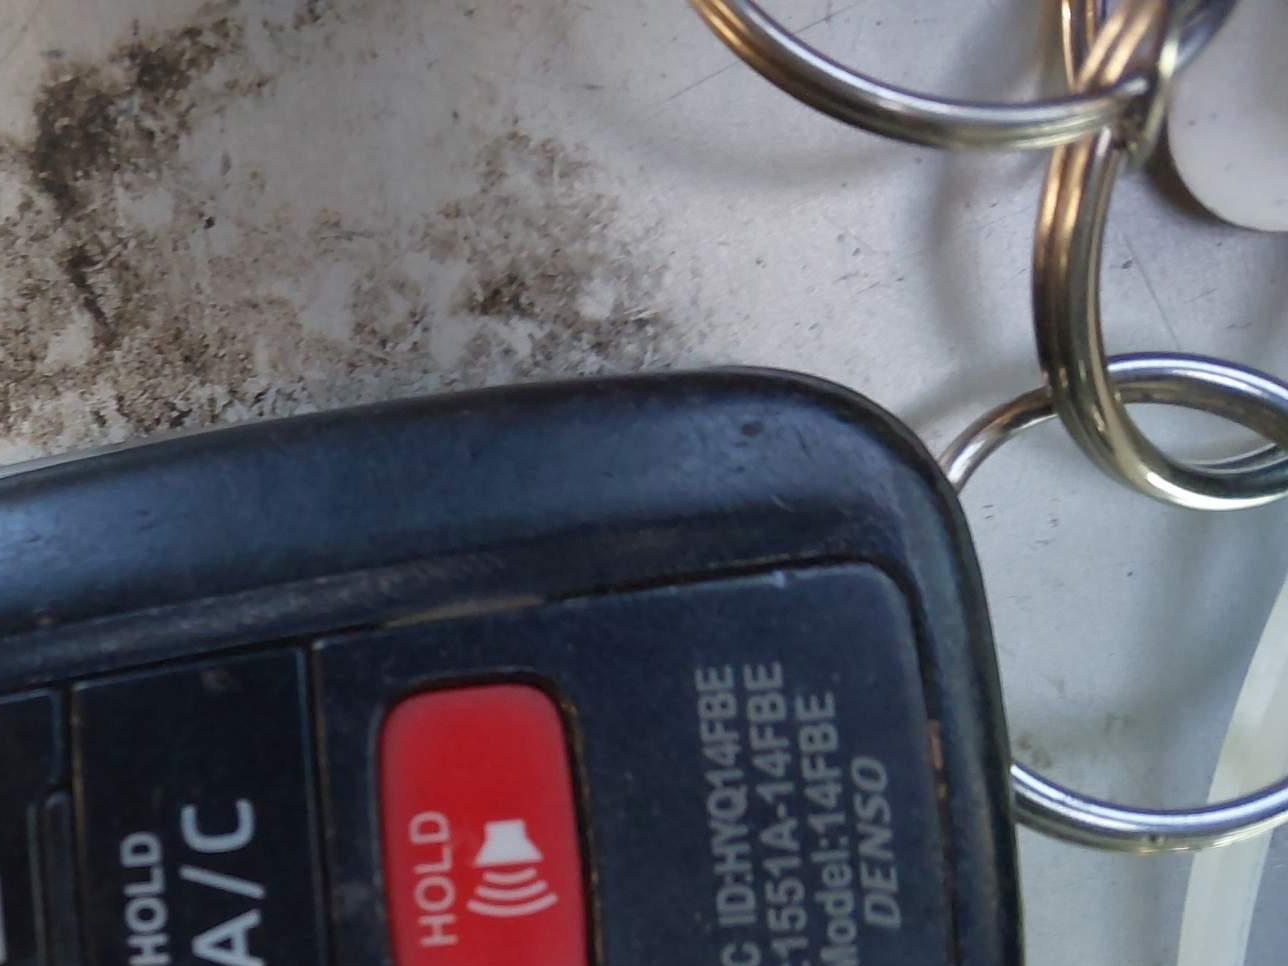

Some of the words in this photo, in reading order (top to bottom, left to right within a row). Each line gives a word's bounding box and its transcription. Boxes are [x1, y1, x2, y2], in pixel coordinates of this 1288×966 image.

[409, 811, 459, 948] HOLD
[695, 665, 758, 929] ID:HYQ14FBE
[850, 755, 902, 929] DENSO
